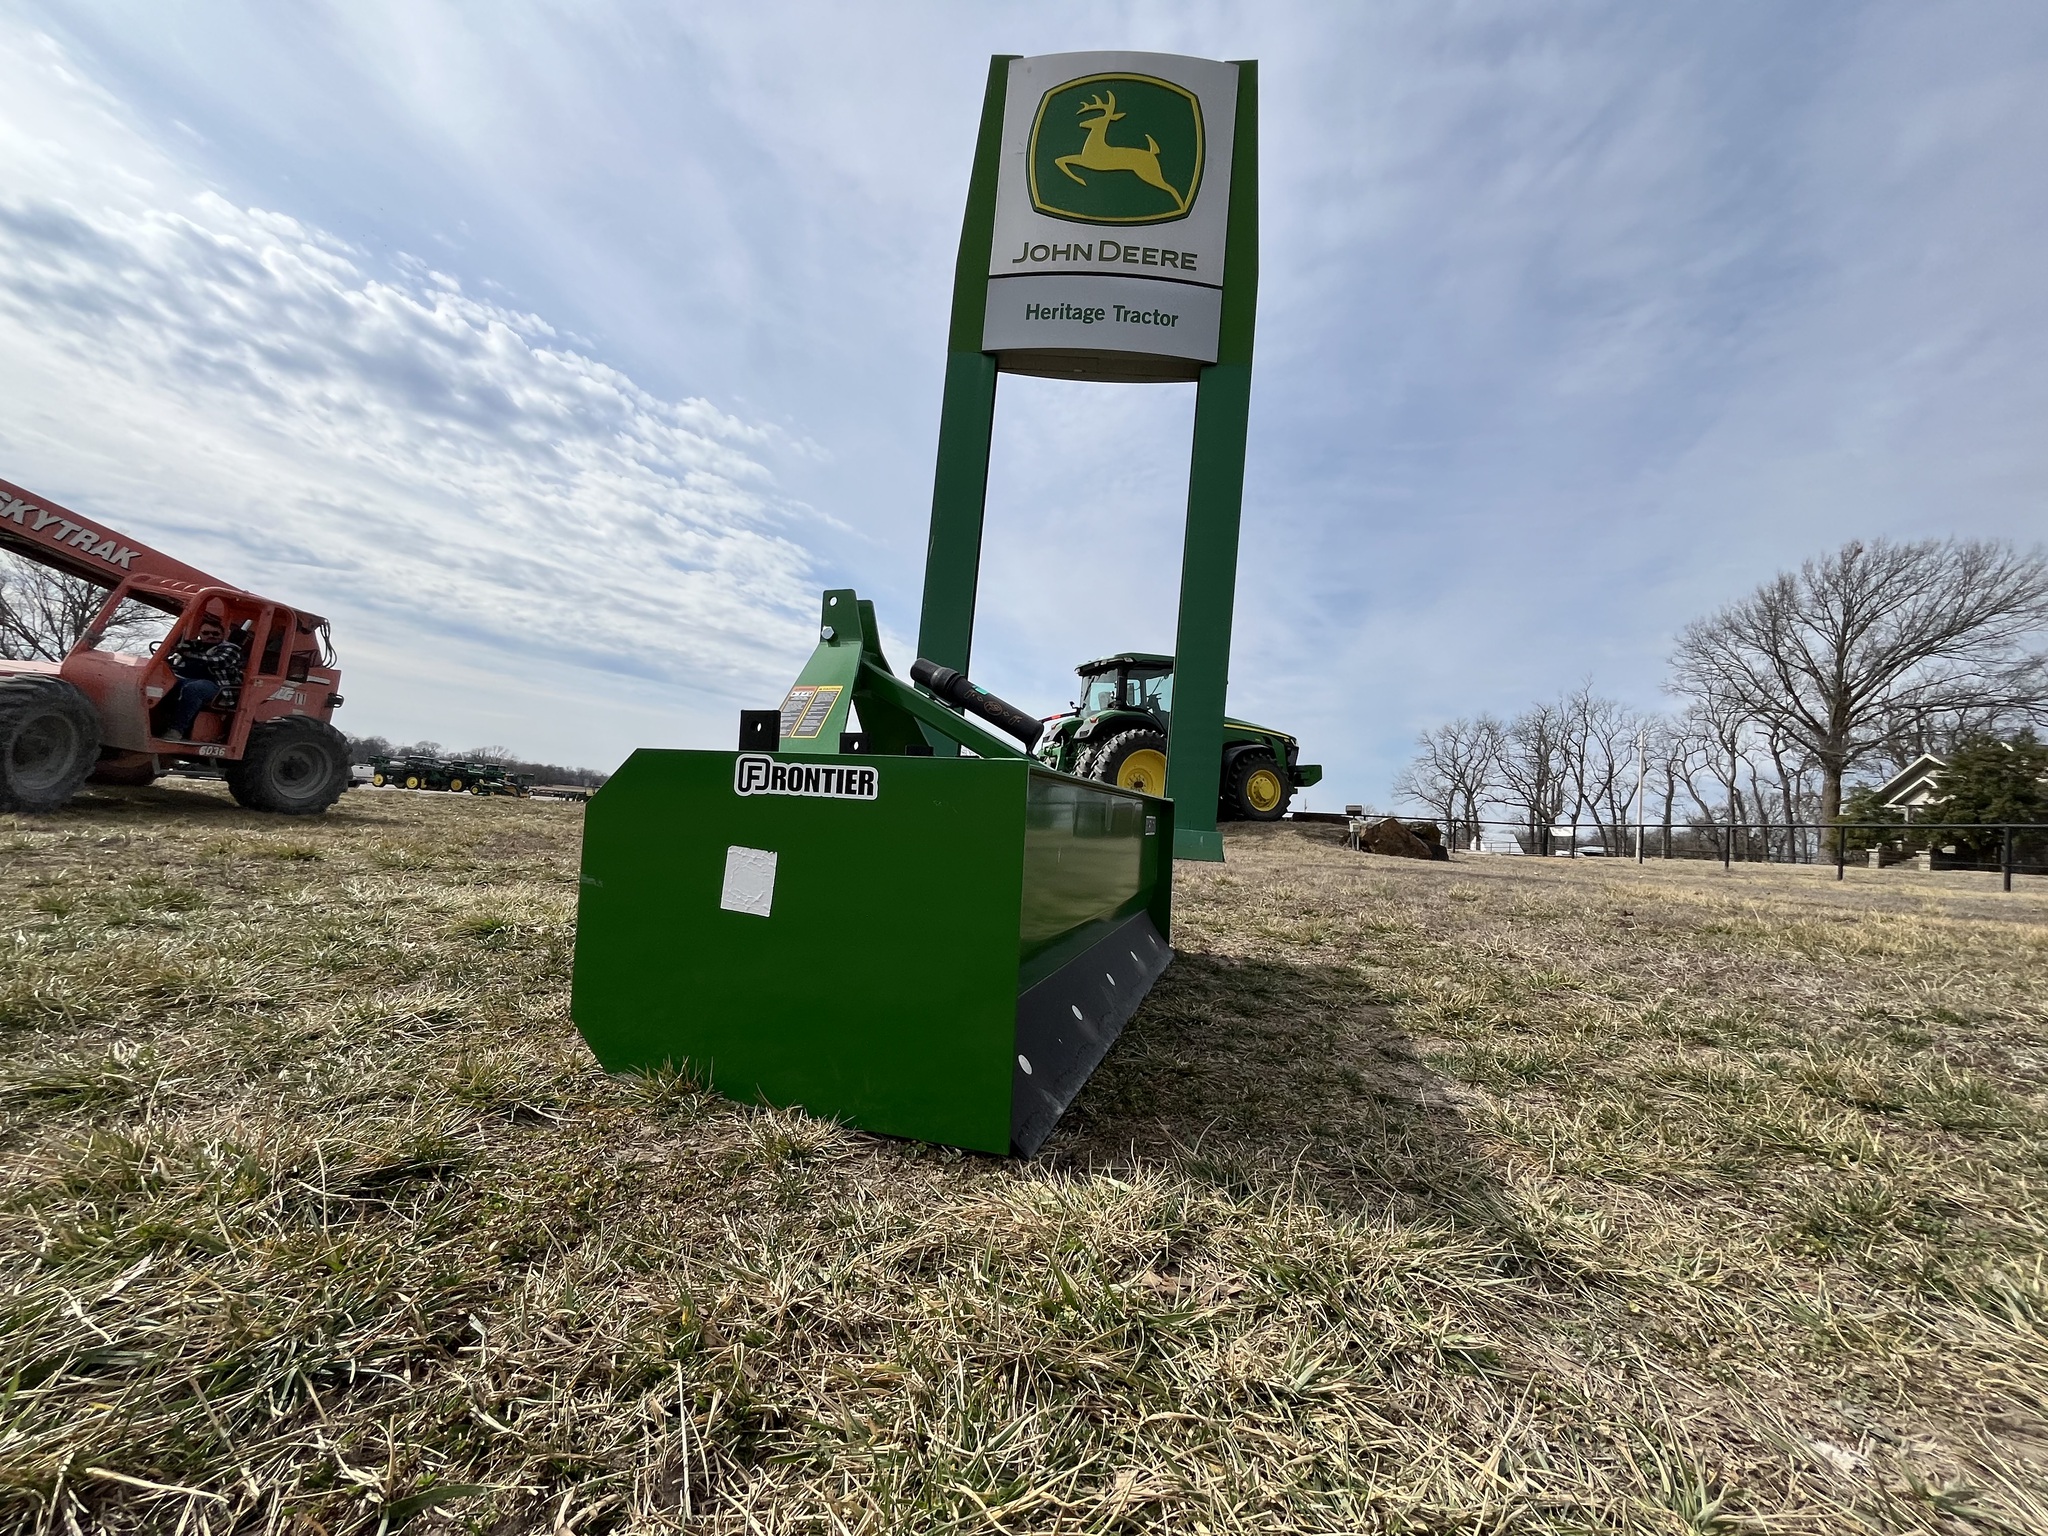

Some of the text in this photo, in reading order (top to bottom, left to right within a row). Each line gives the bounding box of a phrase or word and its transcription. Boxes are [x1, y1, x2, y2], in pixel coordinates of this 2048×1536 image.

[1012, 240, 1198, 271] JOHN DEERE
[1025, 302, 1179, 328] Heritage Tractor
[199, 745, 226, 757] 6036
[737, 757, 875, 796] FRONTIER
